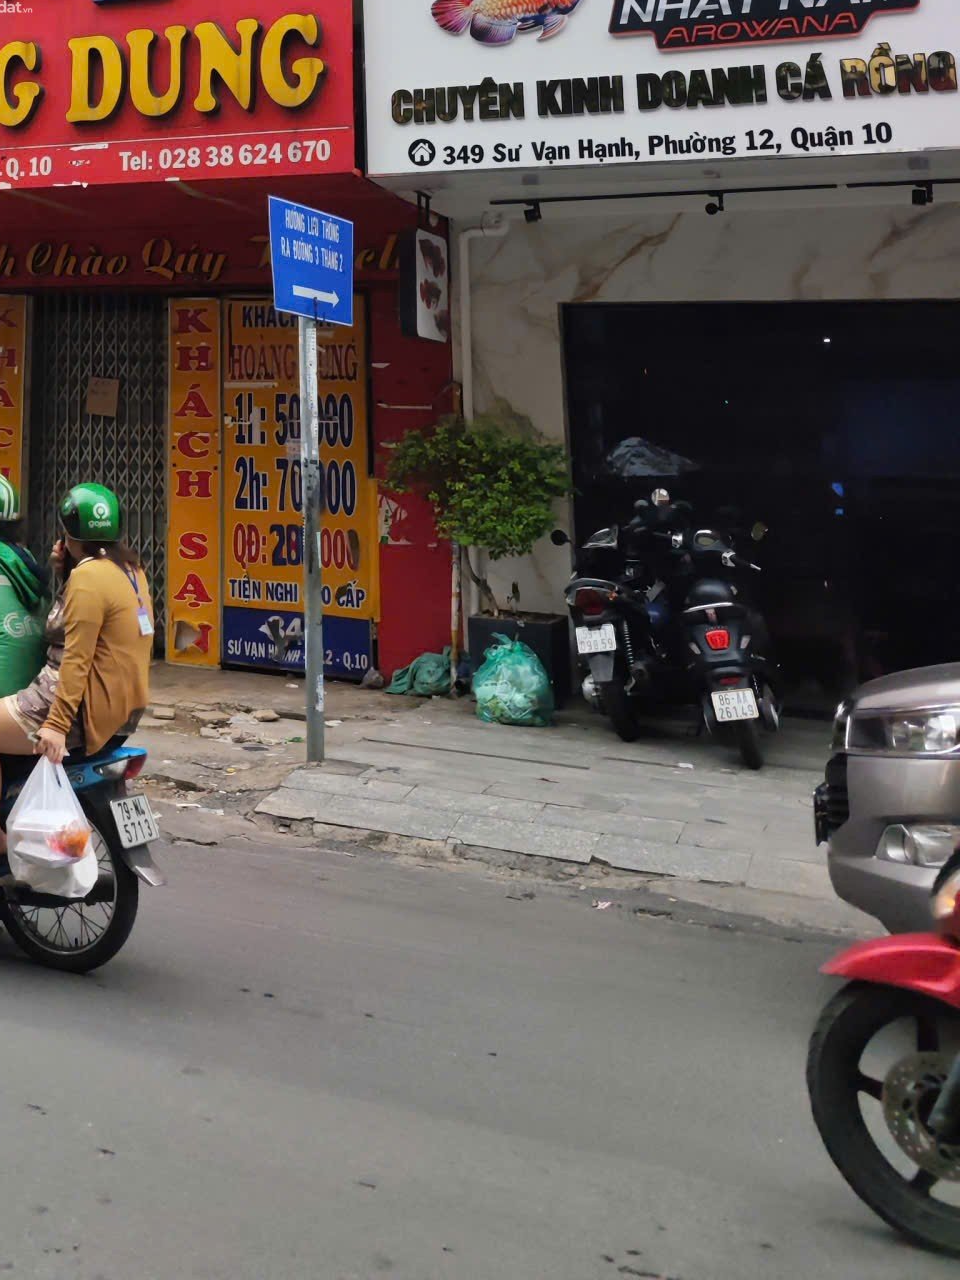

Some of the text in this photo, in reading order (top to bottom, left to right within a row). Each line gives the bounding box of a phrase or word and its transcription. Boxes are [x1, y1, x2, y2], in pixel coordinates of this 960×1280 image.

[662, 12, 858, 45] AROWANA
[65, 13, 326, 125] DUNG
[391, 42, 958, 125] CHUYÊN KINH DOANH CÁ RỒNG
[119, 140, 331, 171] Tel: 028 38 624 670
[443, 123, 893, 166] 349 Sư Vạn Hạnh, Phường 12, Quận 10
[322, 218, 340, 243] THÔNG
[24, 242, 129, 277] Chào
[141, 237, 229, 282] Quý
[280, 237, 290, 256] RA
[314, 246, 320, 265] 3
[321, 245, 339, 271] THÁNG
[317, 339, 358, 381] UNG
[174, 308, 213, 500] KHÁCH
[234, 456, 268, 512] 2h:
[232, 522, 267, 569] QĐ:
[228, 575, 261, 603] TIỆN
[266, 581, 298, 602] NGHI
[228, 638, 243, 655] SƯ
[244, 640, 266, 660] VẠN
[268, 644, 301, 662] HNH
[343, 652, 368, 671] Q.10
[124, 818, 153, 843] 5713
